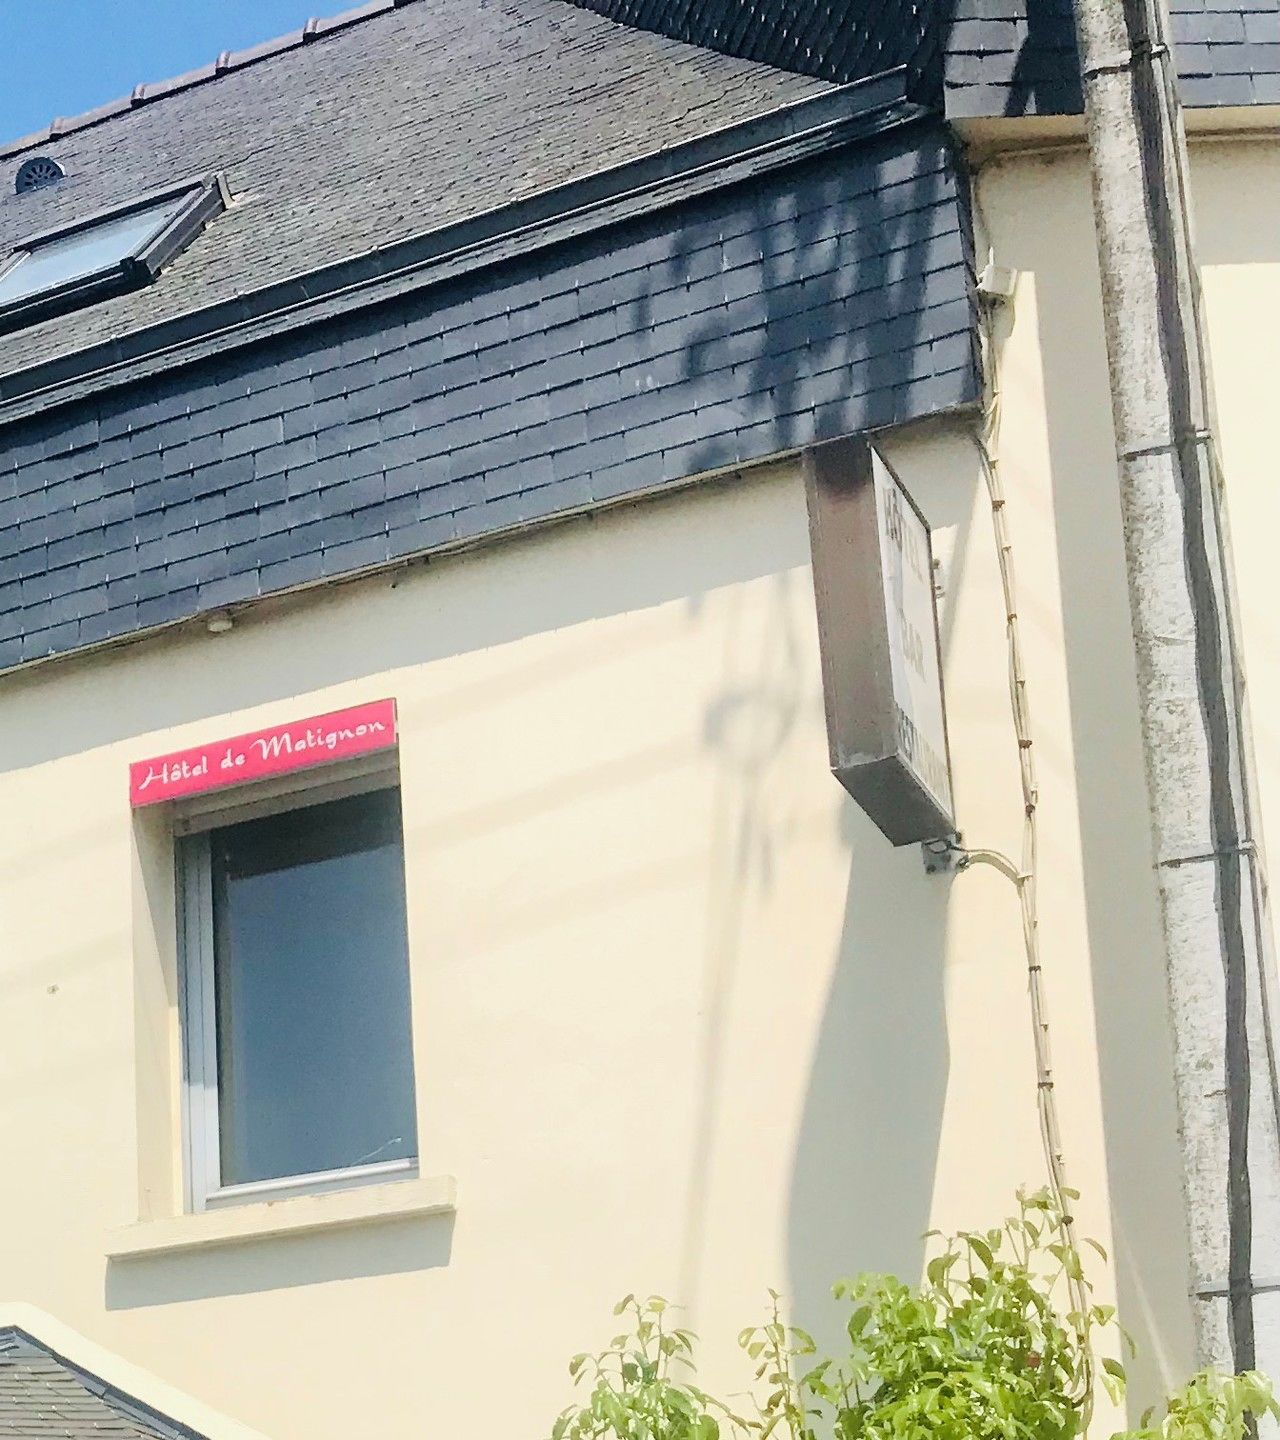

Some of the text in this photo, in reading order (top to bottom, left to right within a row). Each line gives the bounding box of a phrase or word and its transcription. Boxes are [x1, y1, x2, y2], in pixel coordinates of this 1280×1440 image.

[139, 720, 385, 790] Hôtel de Matignon
